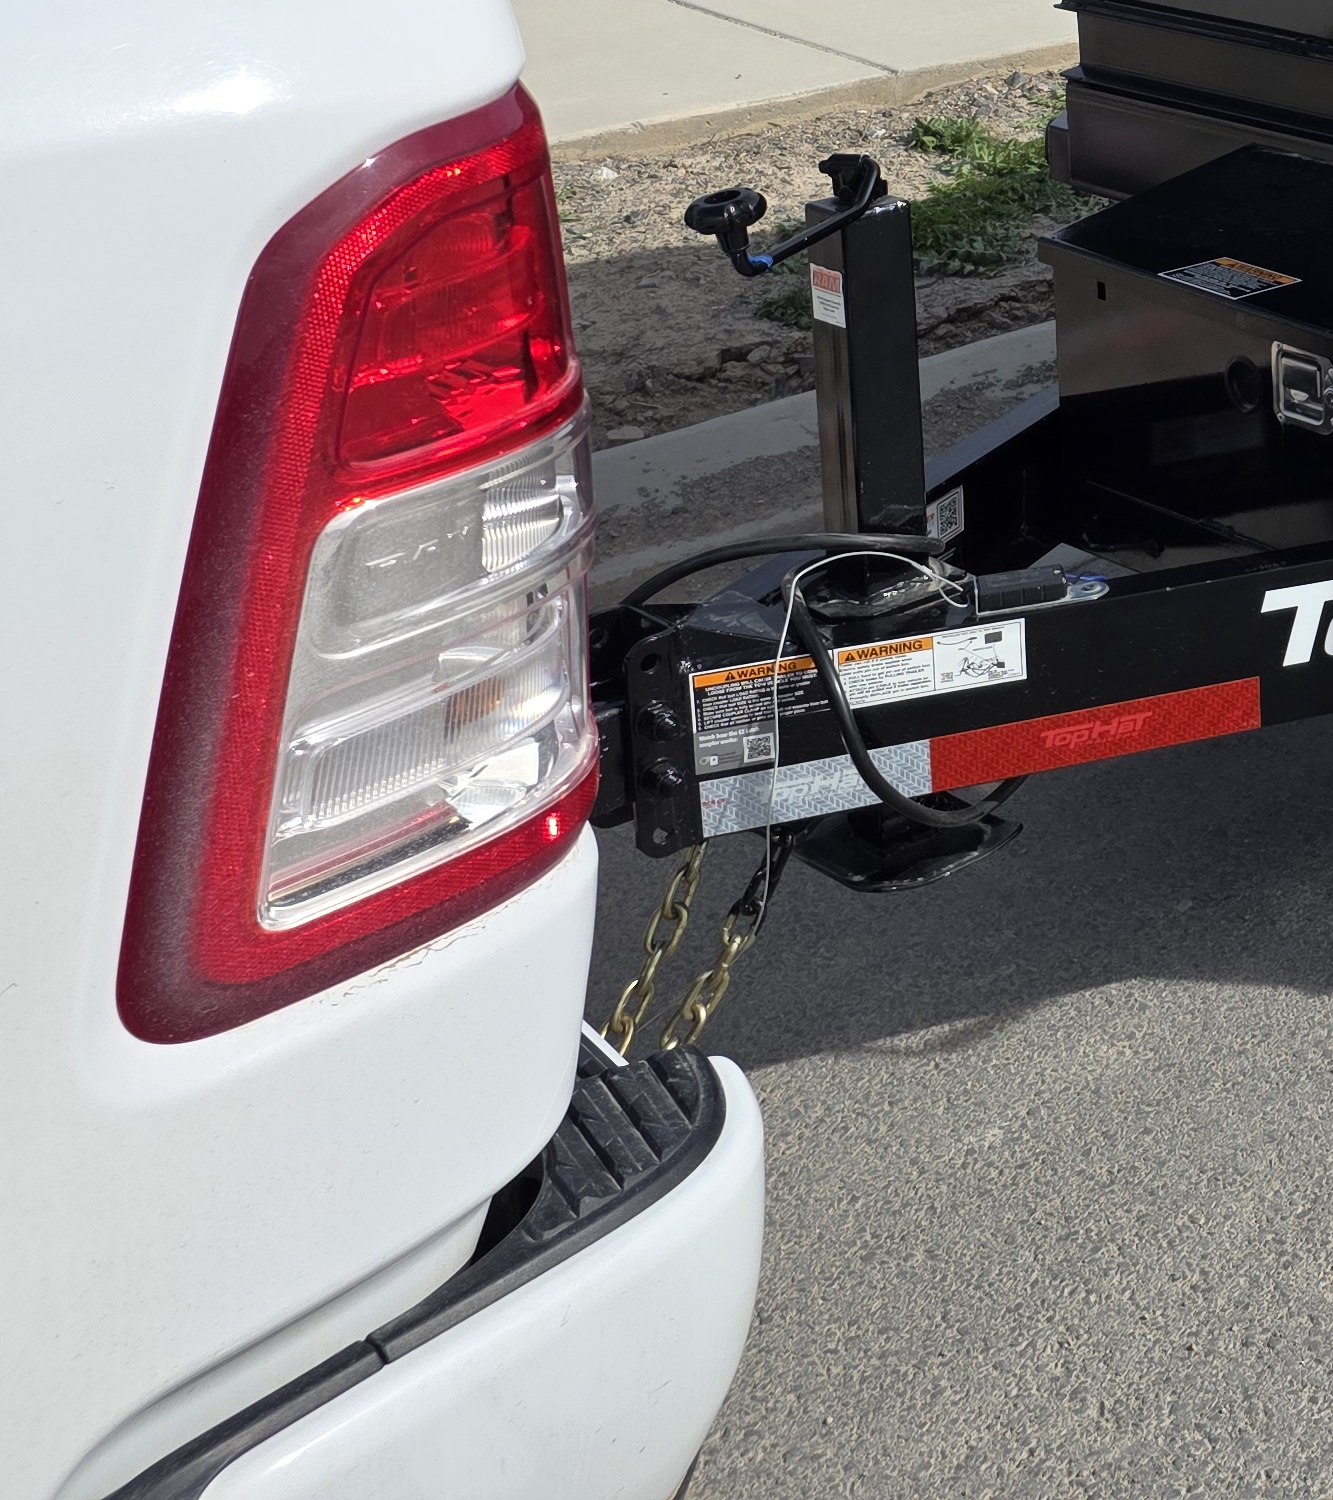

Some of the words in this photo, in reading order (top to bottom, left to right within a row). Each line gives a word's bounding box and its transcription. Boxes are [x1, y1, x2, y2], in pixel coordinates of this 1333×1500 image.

[814, 271, 840, 294] RAM
[856, 640, 923, 660] WARNING
[736, 661, 798, 679] WARNNG
